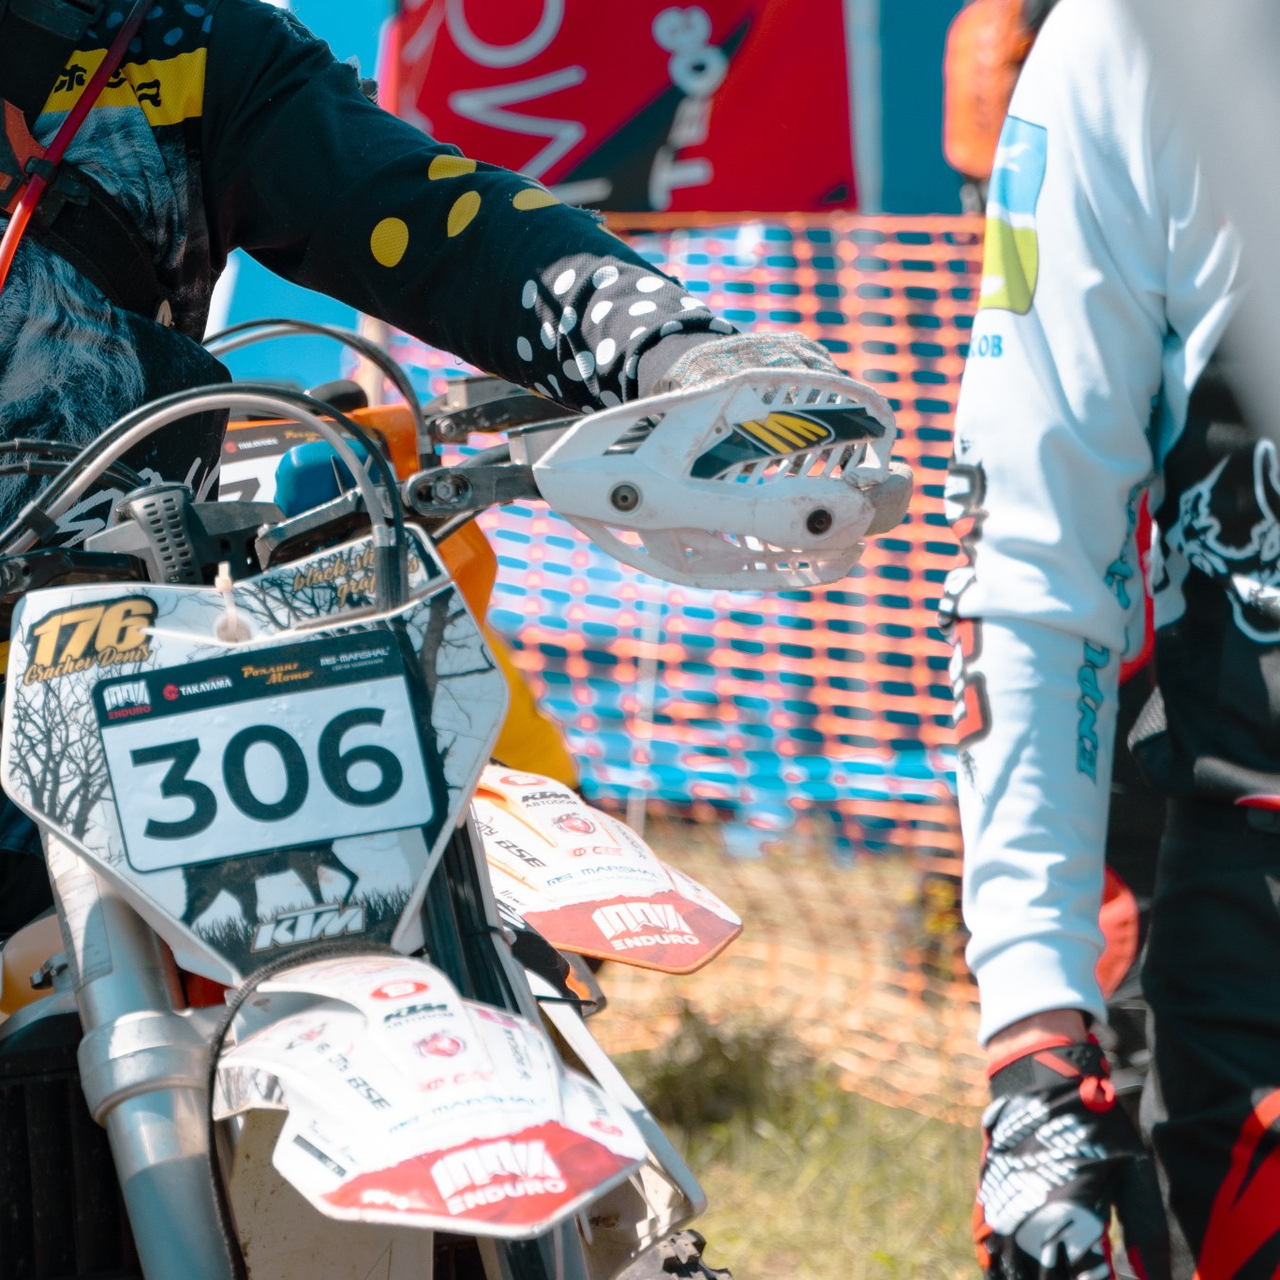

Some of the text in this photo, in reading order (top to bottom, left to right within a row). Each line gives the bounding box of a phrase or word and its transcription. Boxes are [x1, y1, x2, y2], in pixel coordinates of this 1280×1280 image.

[33, 599, 153, 666] 176
[99, 641, 152, 669] Denis
[179, 677, 232, 697] TAKAYAMA
[108, 704, 153, 720] ENDURO
[130, 707, 404, 840] 306
[250, 903, 366, 953] KTM
[610, 933, 700, 951] ENDURO
[445, 1176, 567, 1215] ENDURO
